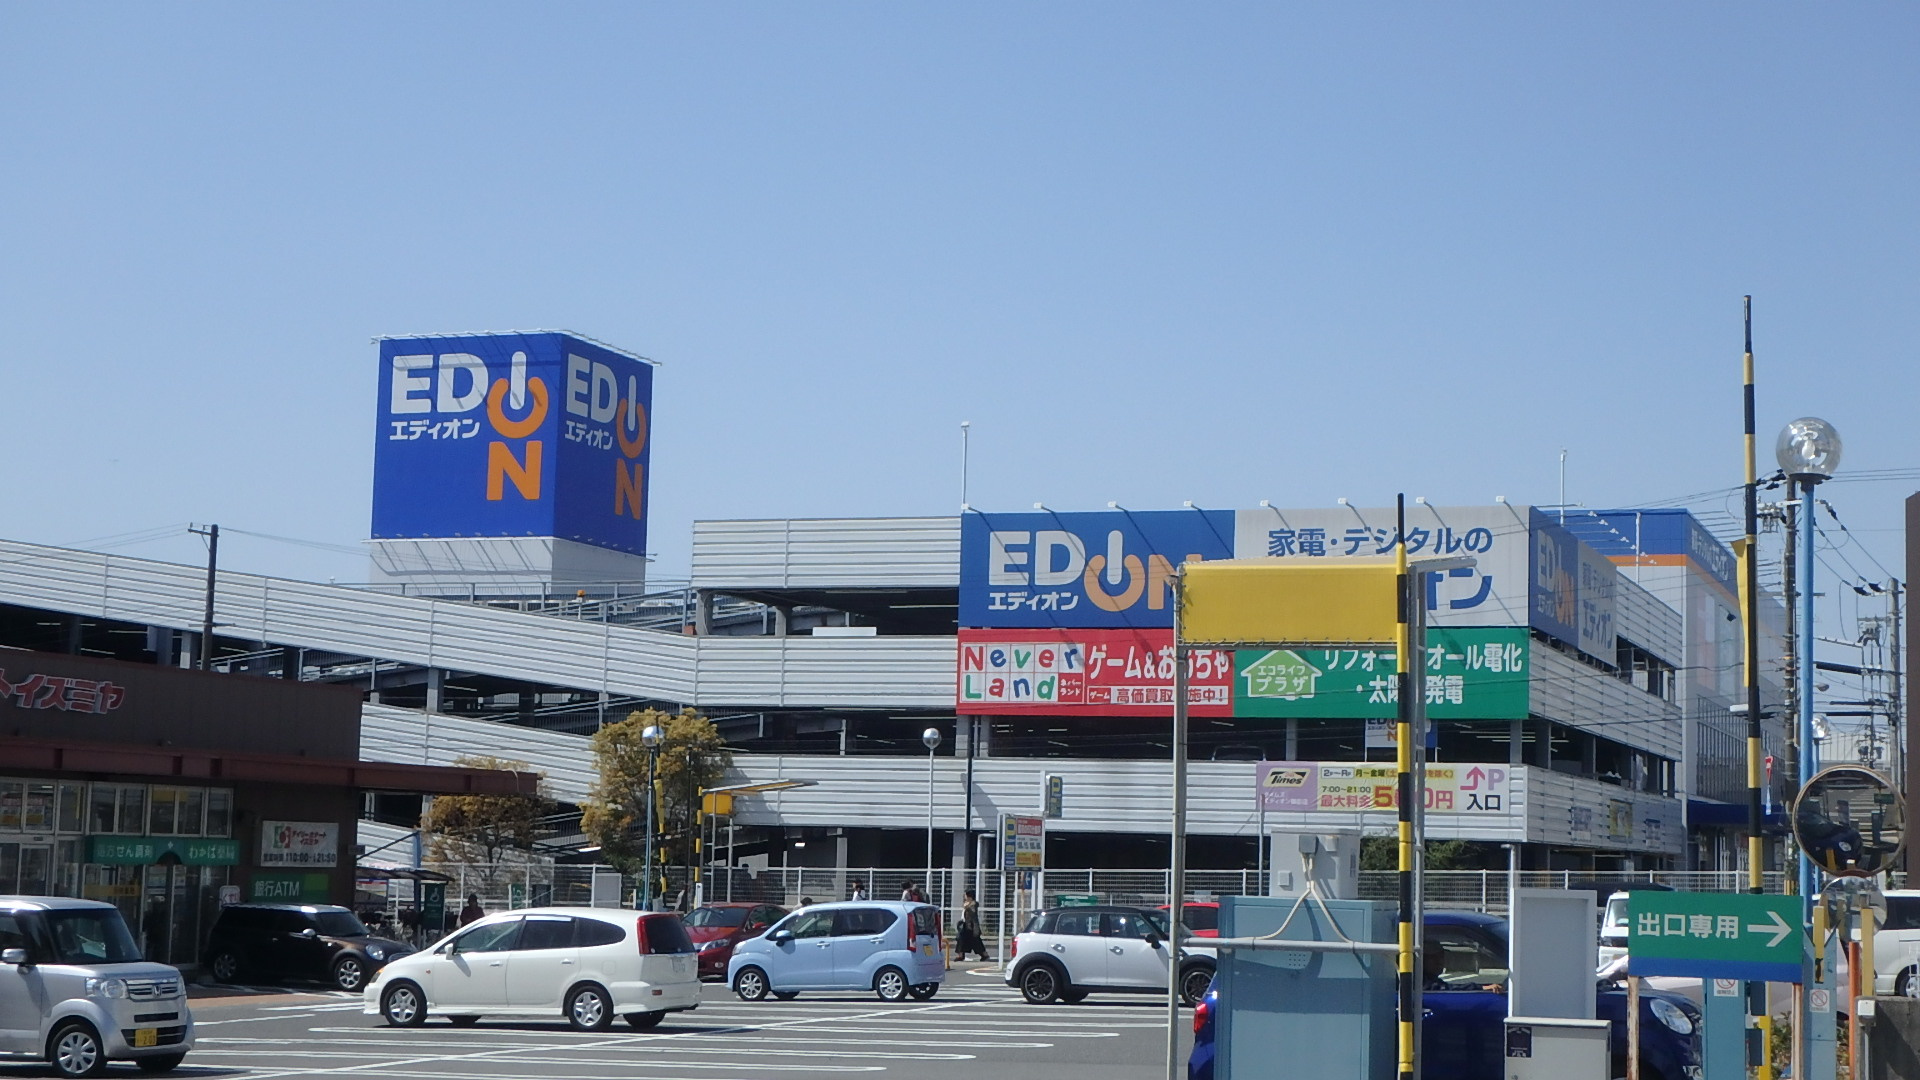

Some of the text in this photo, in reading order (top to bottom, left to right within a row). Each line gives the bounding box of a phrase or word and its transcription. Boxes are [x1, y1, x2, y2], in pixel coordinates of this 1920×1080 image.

[390, 418, 480, 440] エディオン
[565, 420, 613, 450] エディオン
[988, 592, 1079, 611] エディオン
[964, 645, 1078, 672] Never
[1257, 665, 1306, 676] エコライフ
[966, 675, 1056, 700] Land
[1256, 676, 1309, 692] プラザ
[1271, 775, 1302, 785] Times
[1487, 768, 1505, 791] P
[1466, 793, 1501, 810] 入口
[254, 880, 300, 897] 銀行ATM
[1637, 912, 1739, 939] 出口専用
